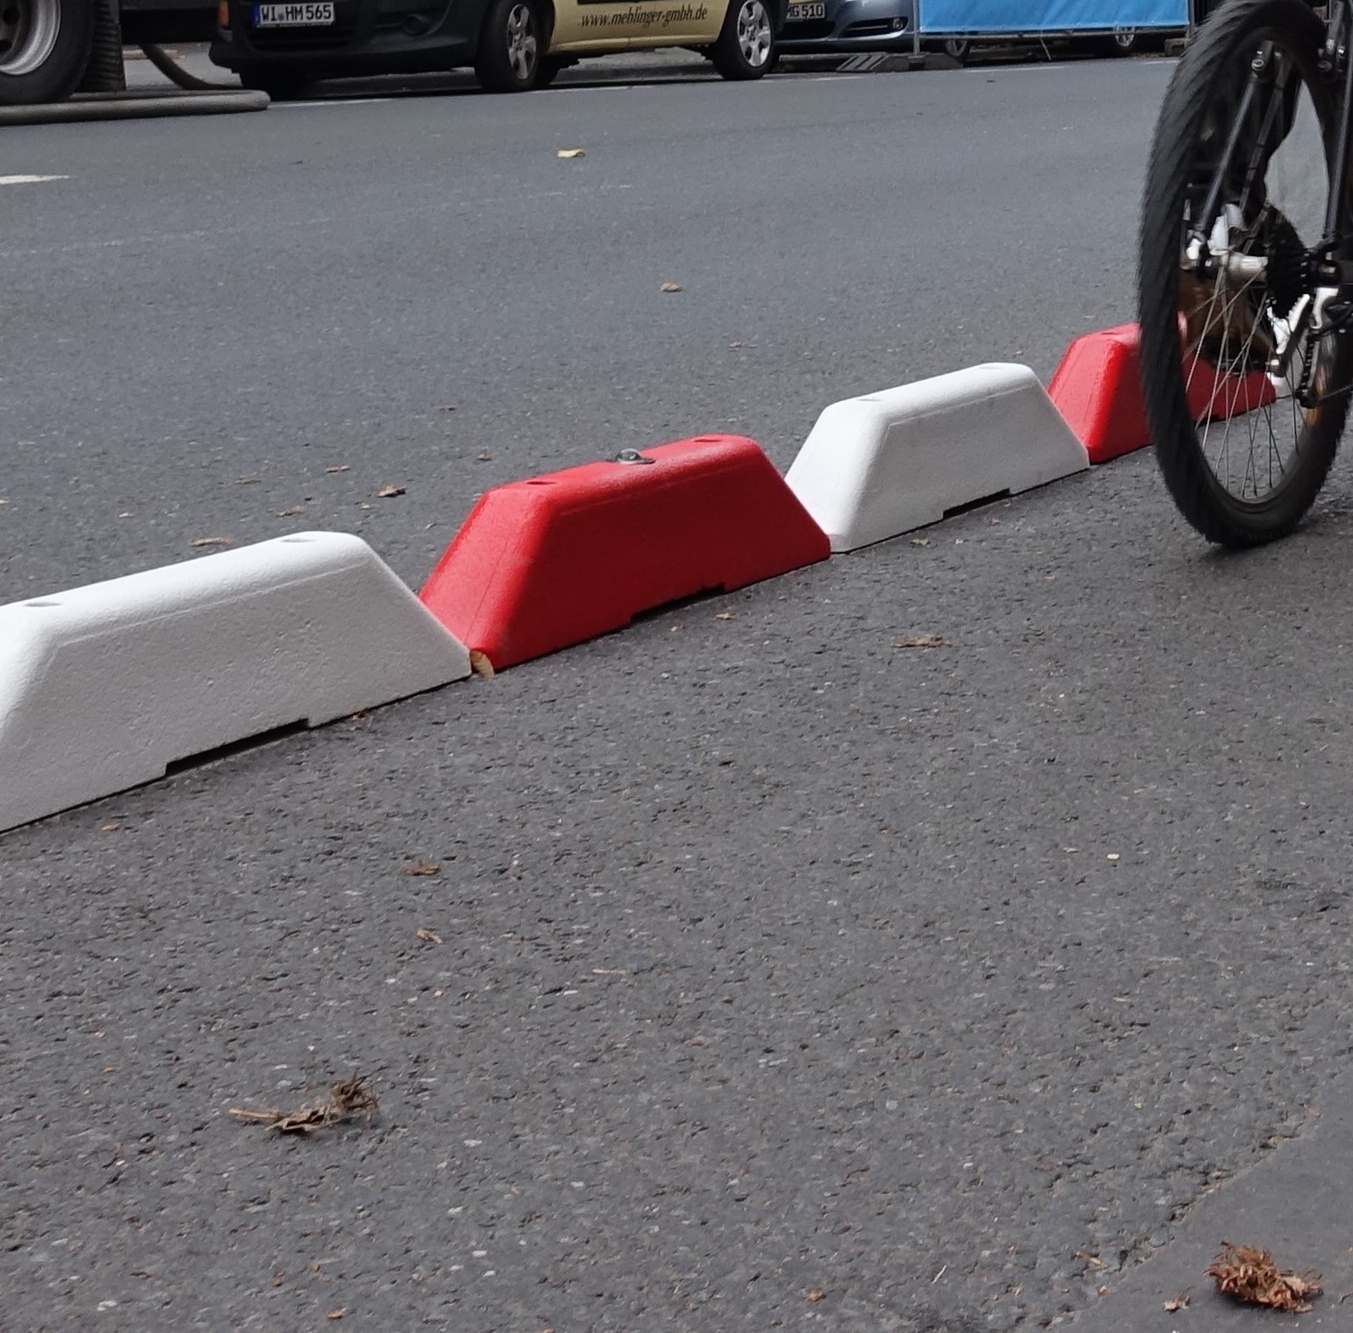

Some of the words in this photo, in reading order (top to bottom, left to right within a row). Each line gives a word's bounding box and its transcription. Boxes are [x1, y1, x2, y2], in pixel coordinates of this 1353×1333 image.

[306, 4, 332, 20] 565
[581, 3, 708, 27] www.mehlinger-gmbh.de
[801, 4, 823, 17] 510
